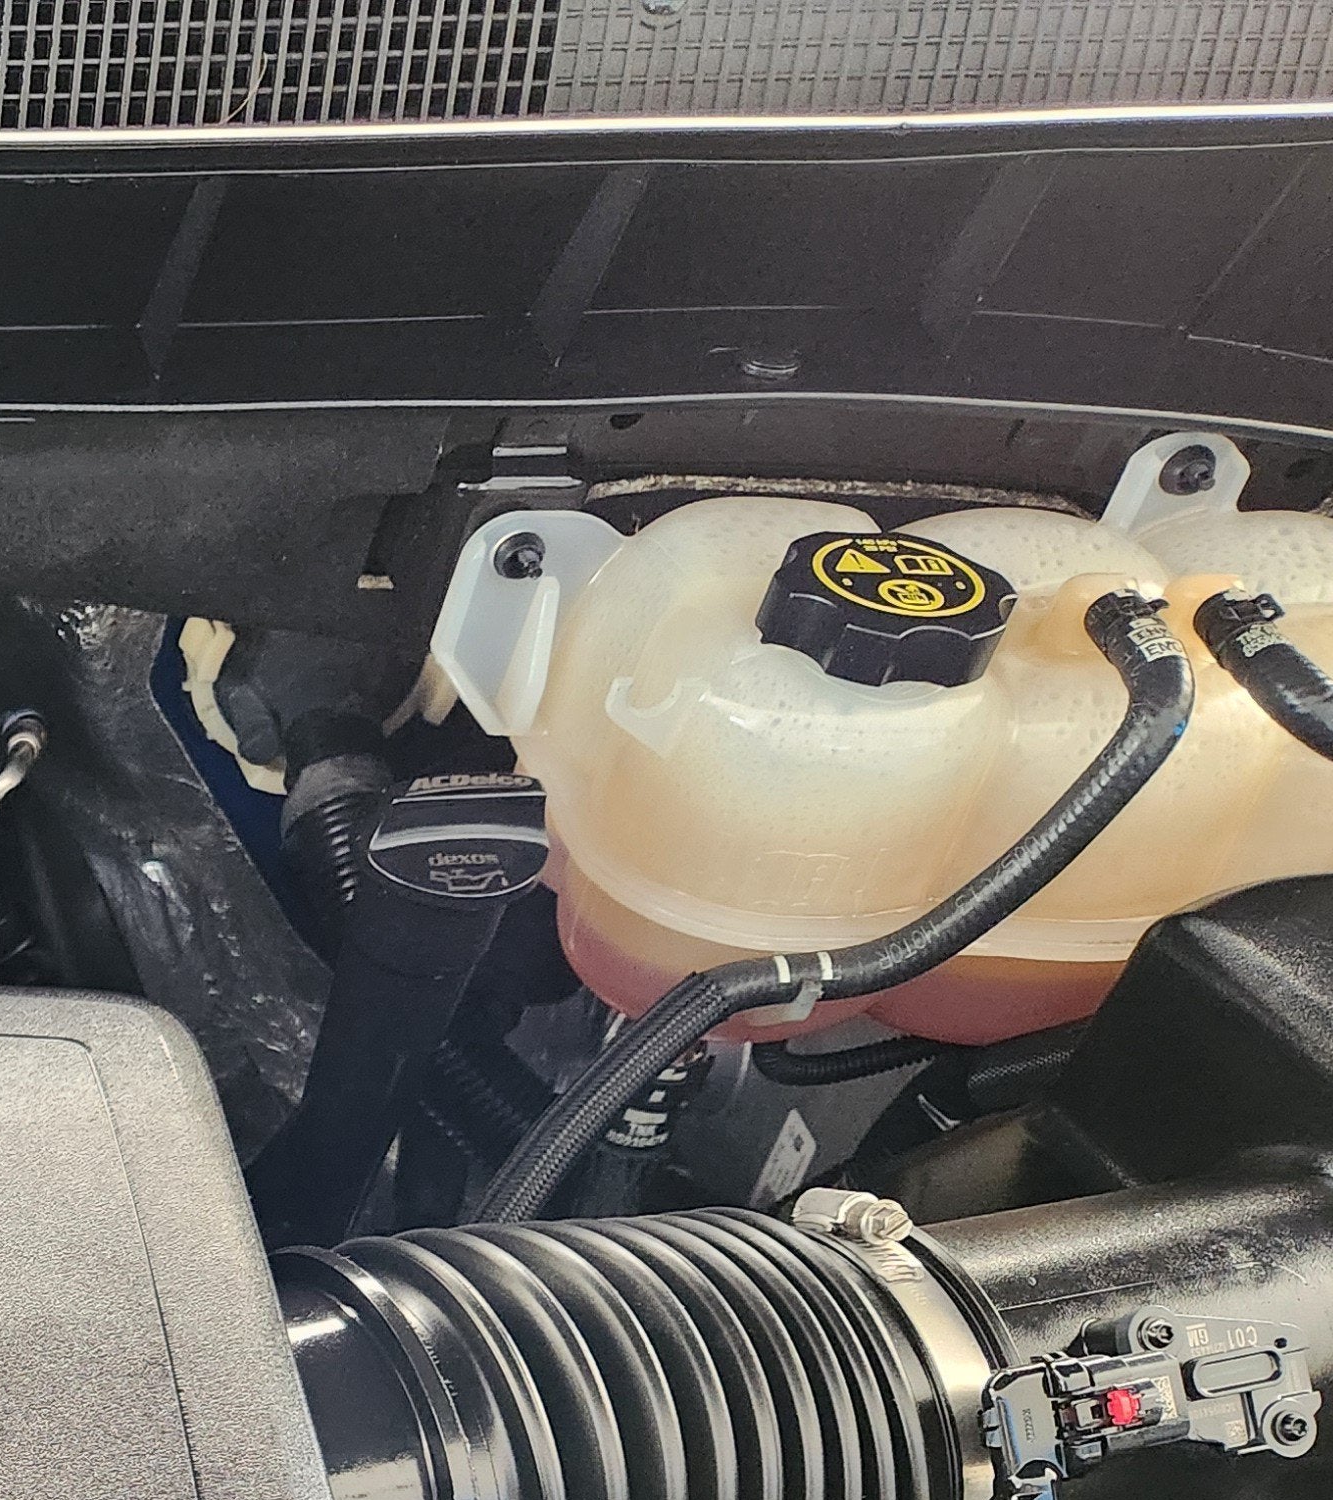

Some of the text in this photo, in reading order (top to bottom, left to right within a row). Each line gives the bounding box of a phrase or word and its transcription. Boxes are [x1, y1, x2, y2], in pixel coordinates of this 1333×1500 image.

[409, 773, 534, 792] ACDelco
[429, 852, 499, 866] dexos
[877, 920, 941, 971] MOTOR
[1186, 1325, 1209, 1347] GM
